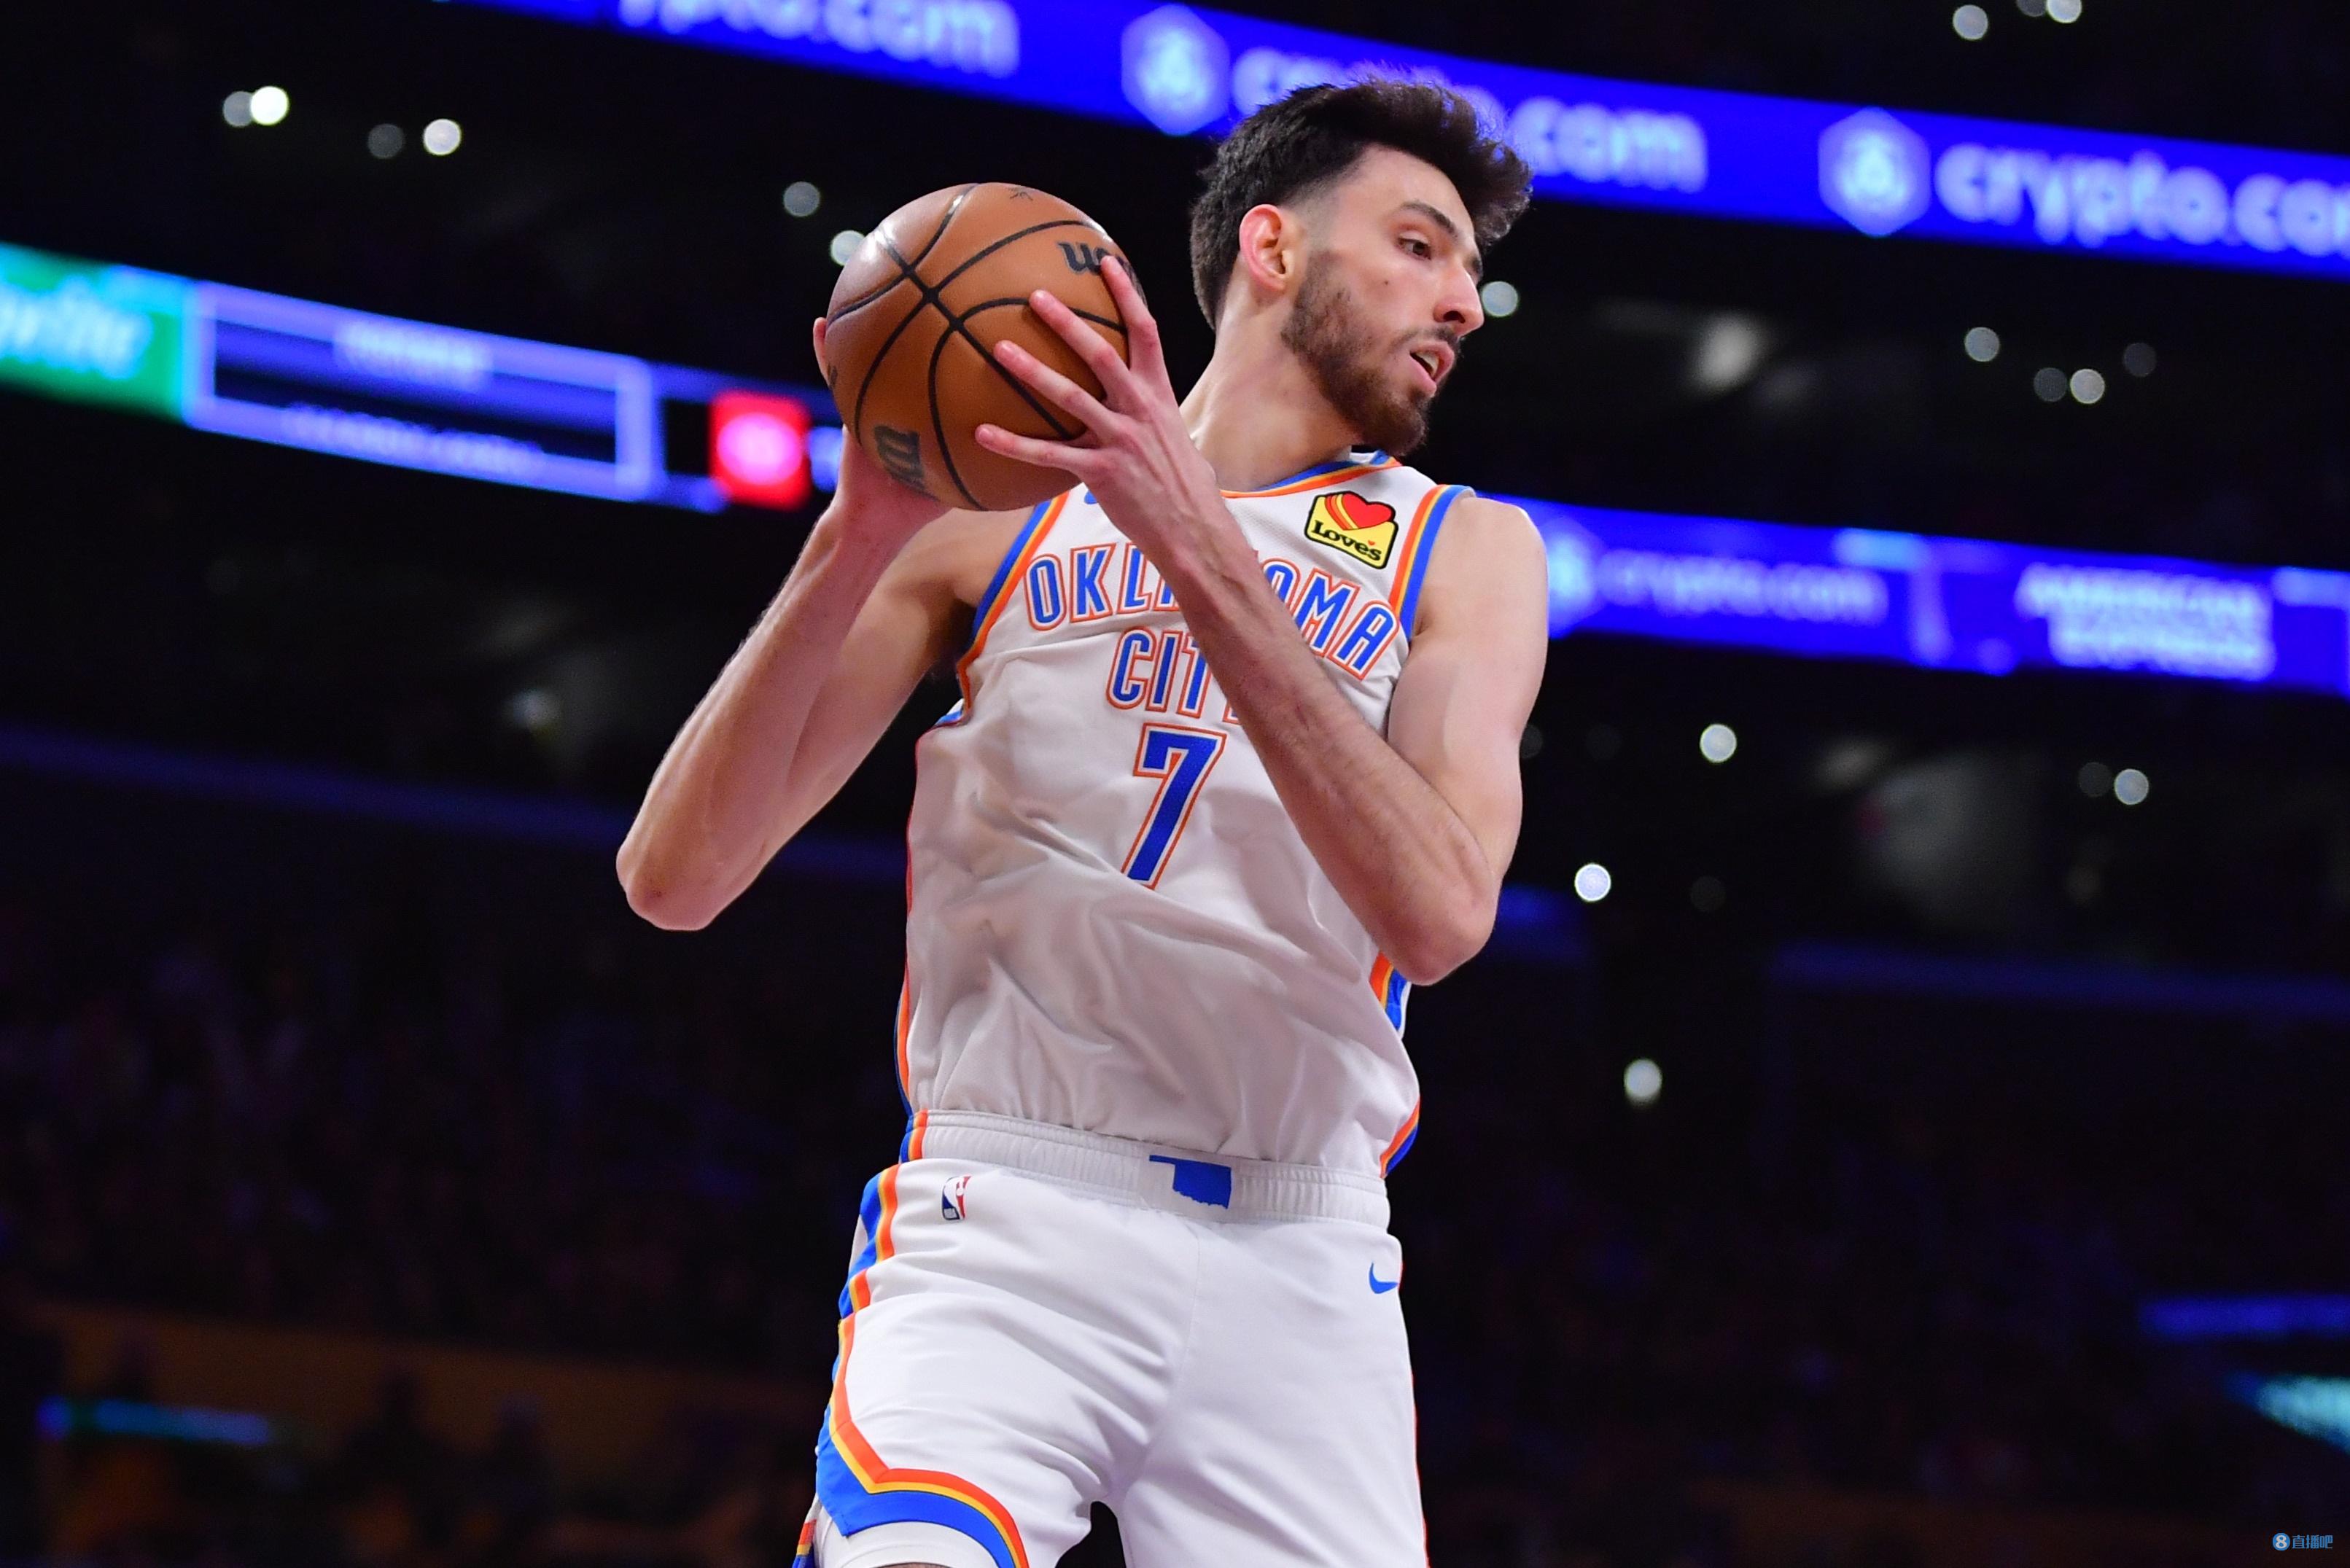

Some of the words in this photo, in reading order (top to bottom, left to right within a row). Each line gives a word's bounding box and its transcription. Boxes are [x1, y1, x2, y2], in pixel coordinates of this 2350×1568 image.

[1936, 144, 2350, 259] crypto.co
[1023, 543, 1400, 680] OKLOMA
[1106, 626, 1242, 722] CIT
[1121, 722, 1227, 891] 7
